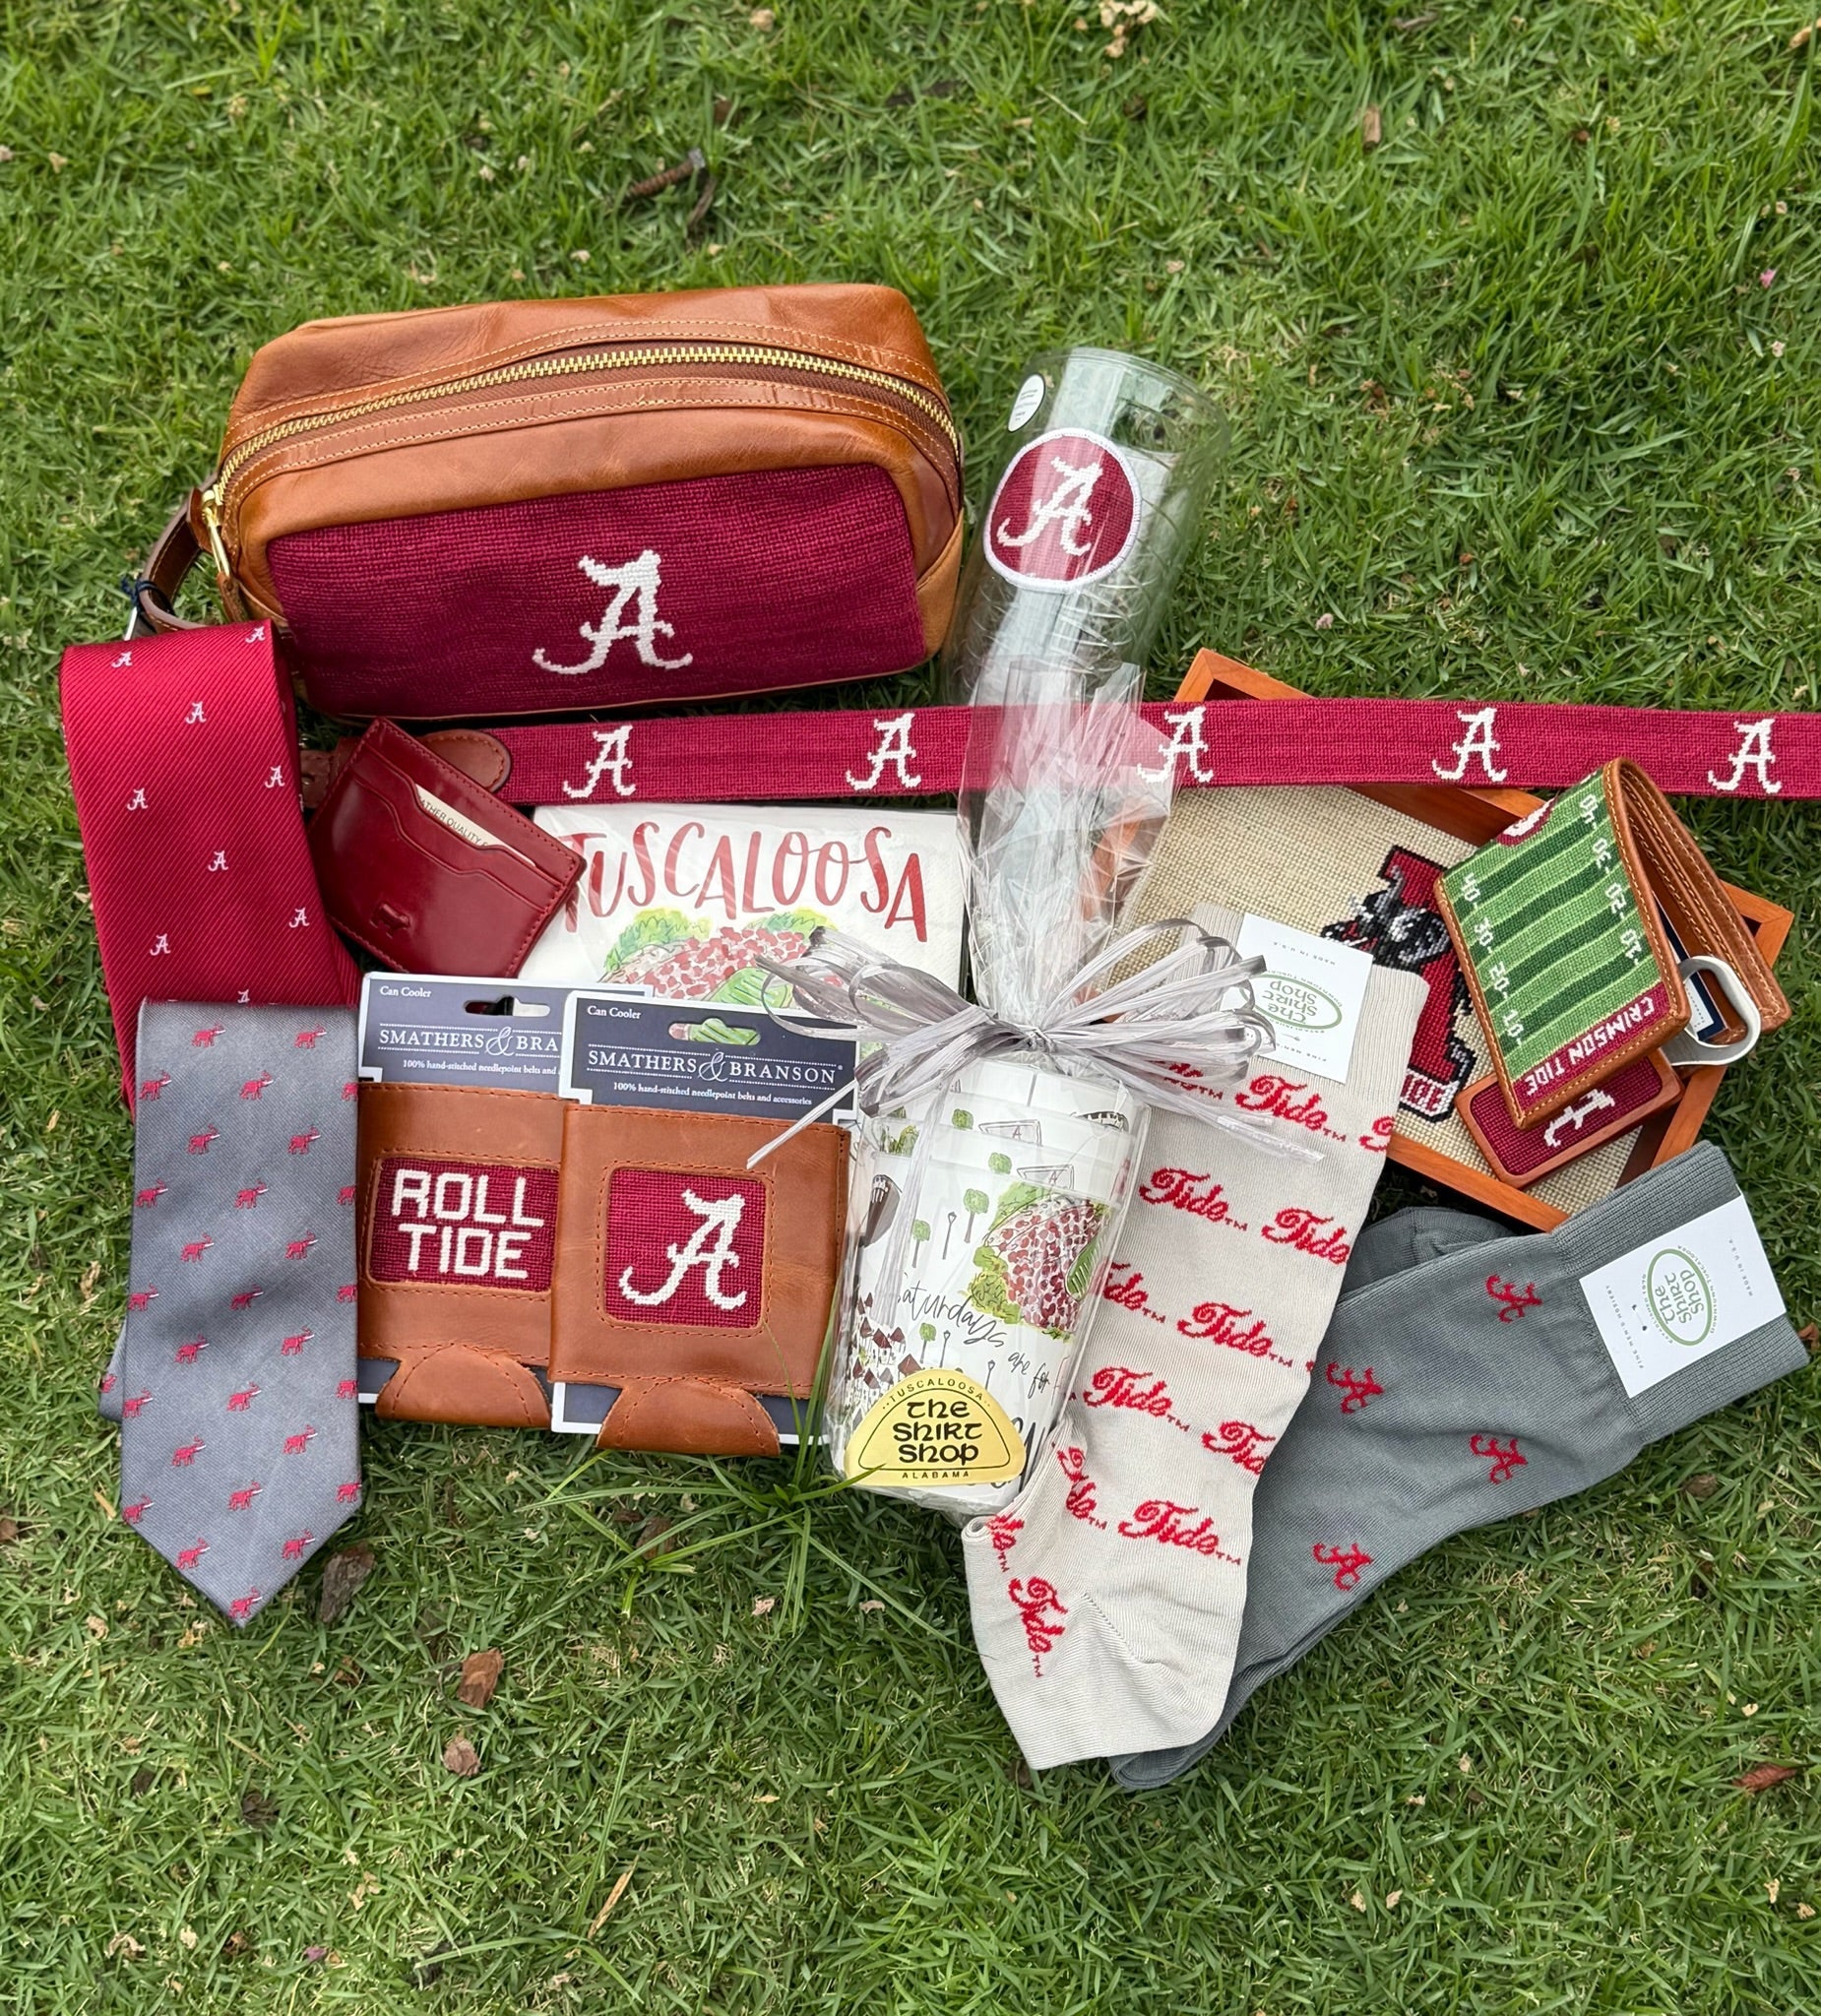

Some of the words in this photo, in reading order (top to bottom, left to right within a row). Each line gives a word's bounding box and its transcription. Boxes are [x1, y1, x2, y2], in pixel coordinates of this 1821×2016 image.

[996, 457, 1102, 556] A
[532, 549, 693, 675] A
[246, 626, 266, 643] A
[112, 652, 132, 667] A
[185, 701, 207, 724] A
[563, 724, 636, 797] A
[846, 713, 921, 790] A
[1137, 706, 1214, 783] A
[1432, 707, 1507, 782] A
[1708, 719, 1783, 793] A
[265, 766, 285, 788] A
[126, 788, 148, 810] A
[208, 850, 228, 872] A
[556, 820, 927, 942] TUSCALOOSA
[288, 908, 309, 927] A
[150, 933, 171, 956] A
[380, 986, 400, 996] Can
[402, 986, 432, 998] Cooler
[587, 1006, 607, 1017] Can
[608, 1007, 641, 1020] Cooler
[1568, 996, 1656, 1065] CRIMSON
[379, 1030, 484, 1048] SMATHERS
[484, 1026, 514, 1056] &
[404, 1060, 425, 1070] 100%
[427, 1061, 476, 1072] hand-stitched
[478, 1063, 522, 1075] needlepoint
[524, 1065, 540, 1075] belts
[541, 1065, 557, 1075] and
[589, 1050, 697, 1073] SMATHERS
[698, 1051, 728, 1082] &
[1524, 1058, 1565, 1097] TIDE
[613, 1083, 636, 1092] 100%
[638, 1083, 690, 1097] hand-stitched
[691, 1089, 736, 1101] needlepoint
[737, 1092, 755, 1101] belts
[756, 1094, 772, 1102] and
[773, 1097, 812, 1106] accessories
[392, 1168, 544, 1228] ROLL
[399, 1224, 532, 1280] TIDE
[619, 1189, 748, 1309] A
[1486, 1275, 1543, 1323] A
[1008, 1352, 1031, 1375] are
[889, 1378, 982, 1402] TUSCALOOSA
[1325, 1360, 1384, 1415] A
[1469, 1433, 1528, 1485] A
[1312, 1542, 1374, 1592] A
